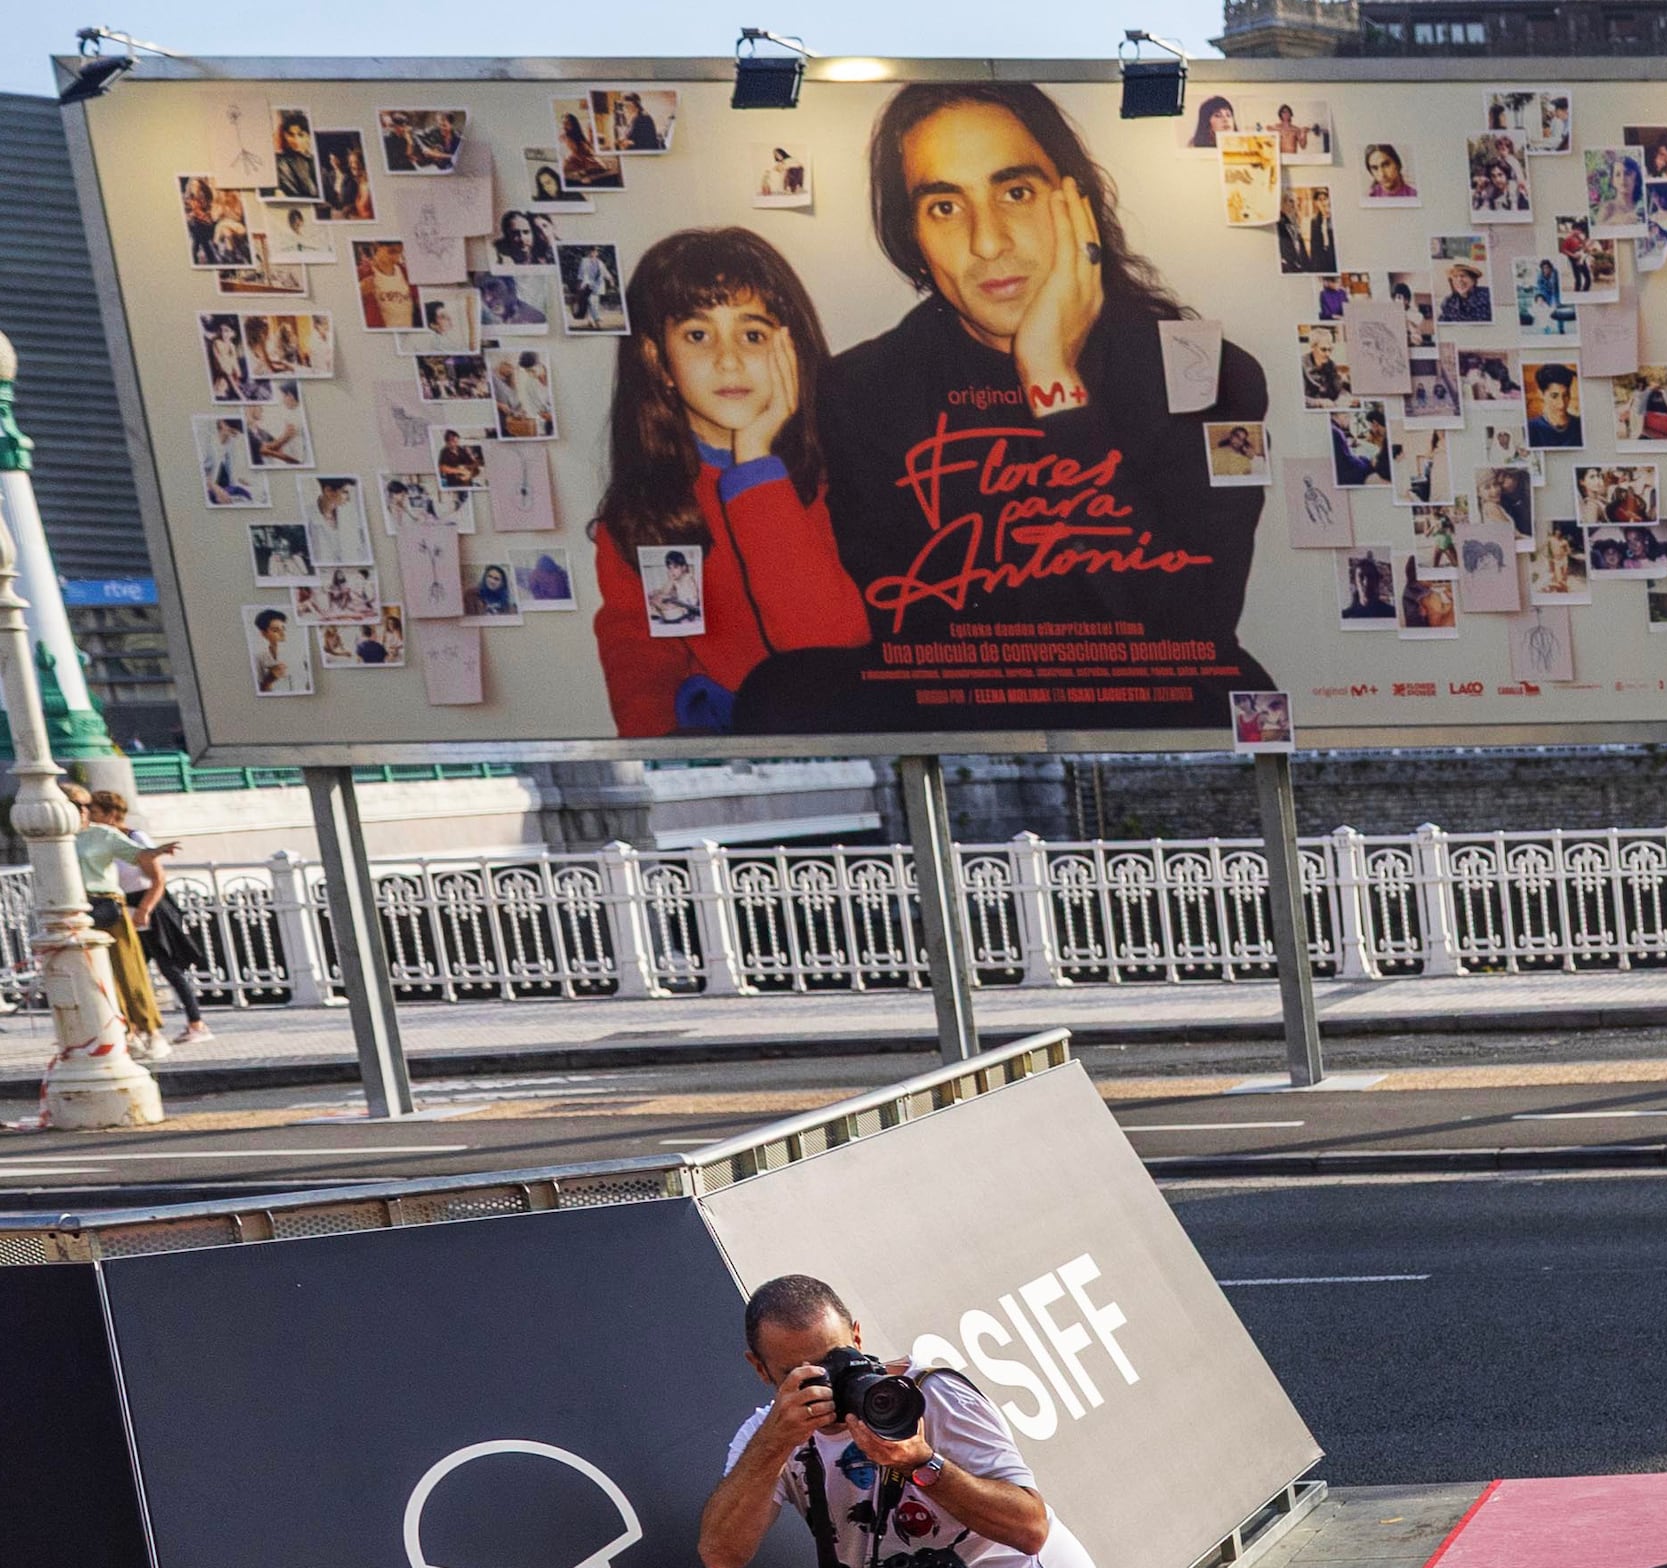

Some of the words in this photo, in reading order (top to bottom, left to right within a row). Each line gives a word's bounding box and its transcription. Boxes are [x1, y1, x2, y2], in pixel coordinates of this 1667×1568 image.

[948, 385, 1024, 410] original
[896, 411, 1122, 531] Flores
[995, 488, 1133, 563] para
[866, 512, 1214, 634] Antonio
[882, 642, 913, 665] Una
[979, 641, 999, 663] de
[1002, 640, 1127, 663] conversaciones
[1130, 639, 1217, 663] pendientes
[1312, 686, 1348, 697] original
